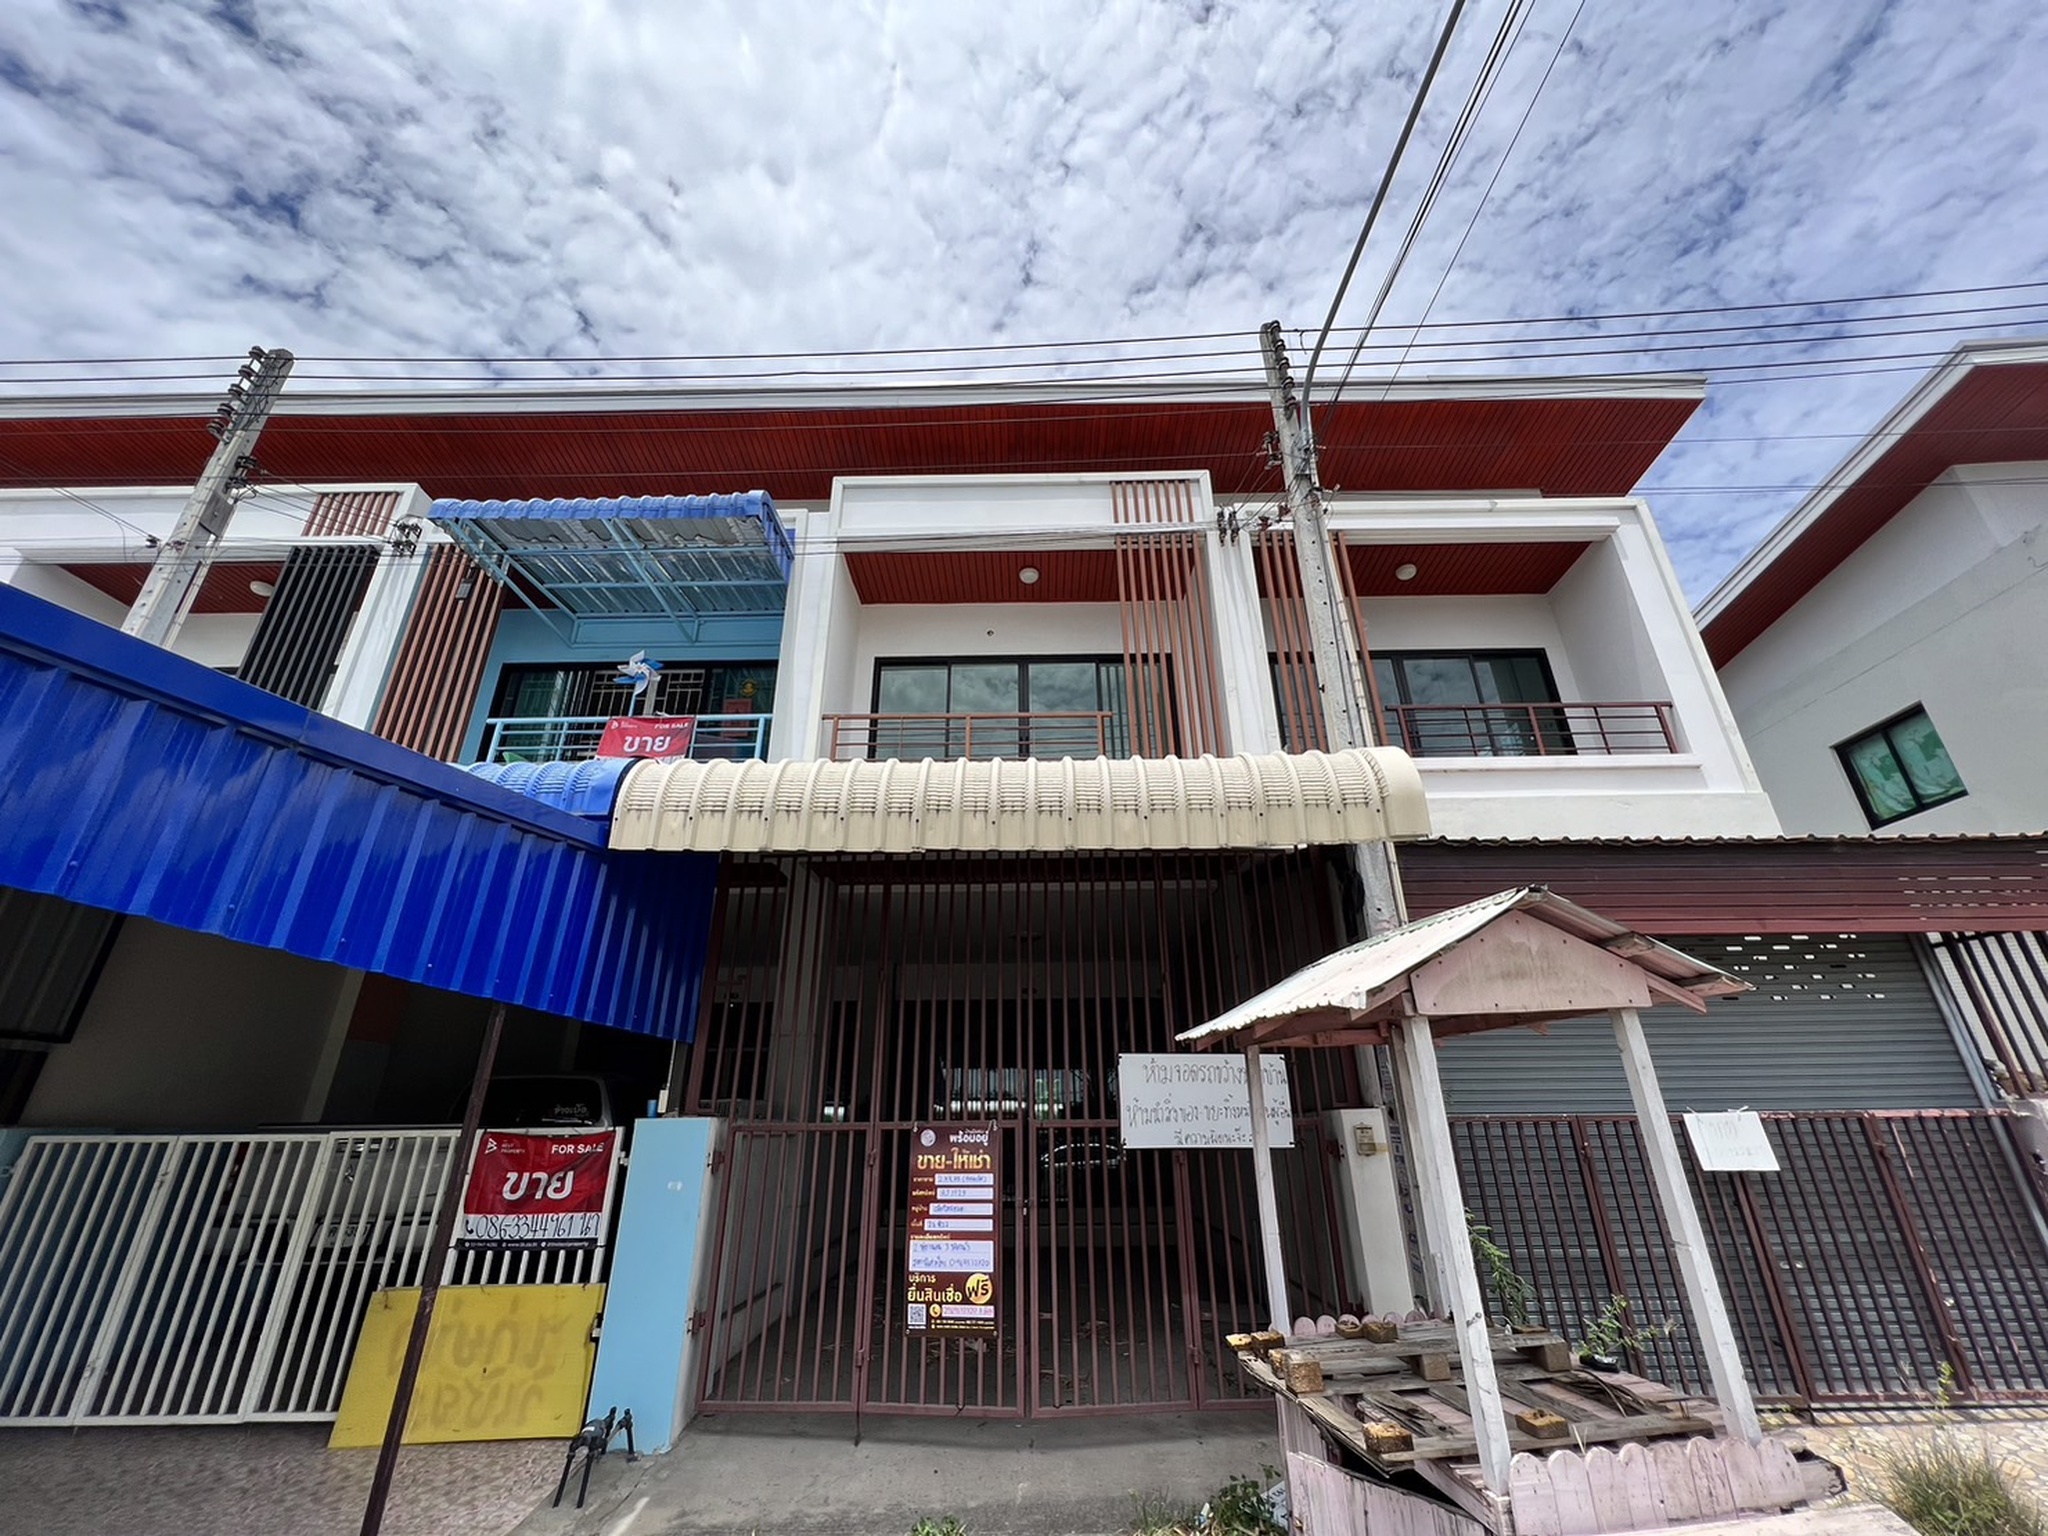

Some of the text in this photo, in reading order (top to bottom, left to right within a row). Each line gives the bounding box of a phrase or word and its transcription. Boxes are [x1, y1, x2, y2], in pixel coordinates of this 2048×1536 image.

[623, 735, 671, 753] ขาย
[551, 1143, 604, 1155] FOR SALE
[917, 1147, 991, 1170] ขาย-ให้เช่า
[502, 1170, 575, 1201] ขาย
[908, 1272, 937, 1283] บริการ
[907, 1282, 963, 1302] ยื่นสินเชื่อ
